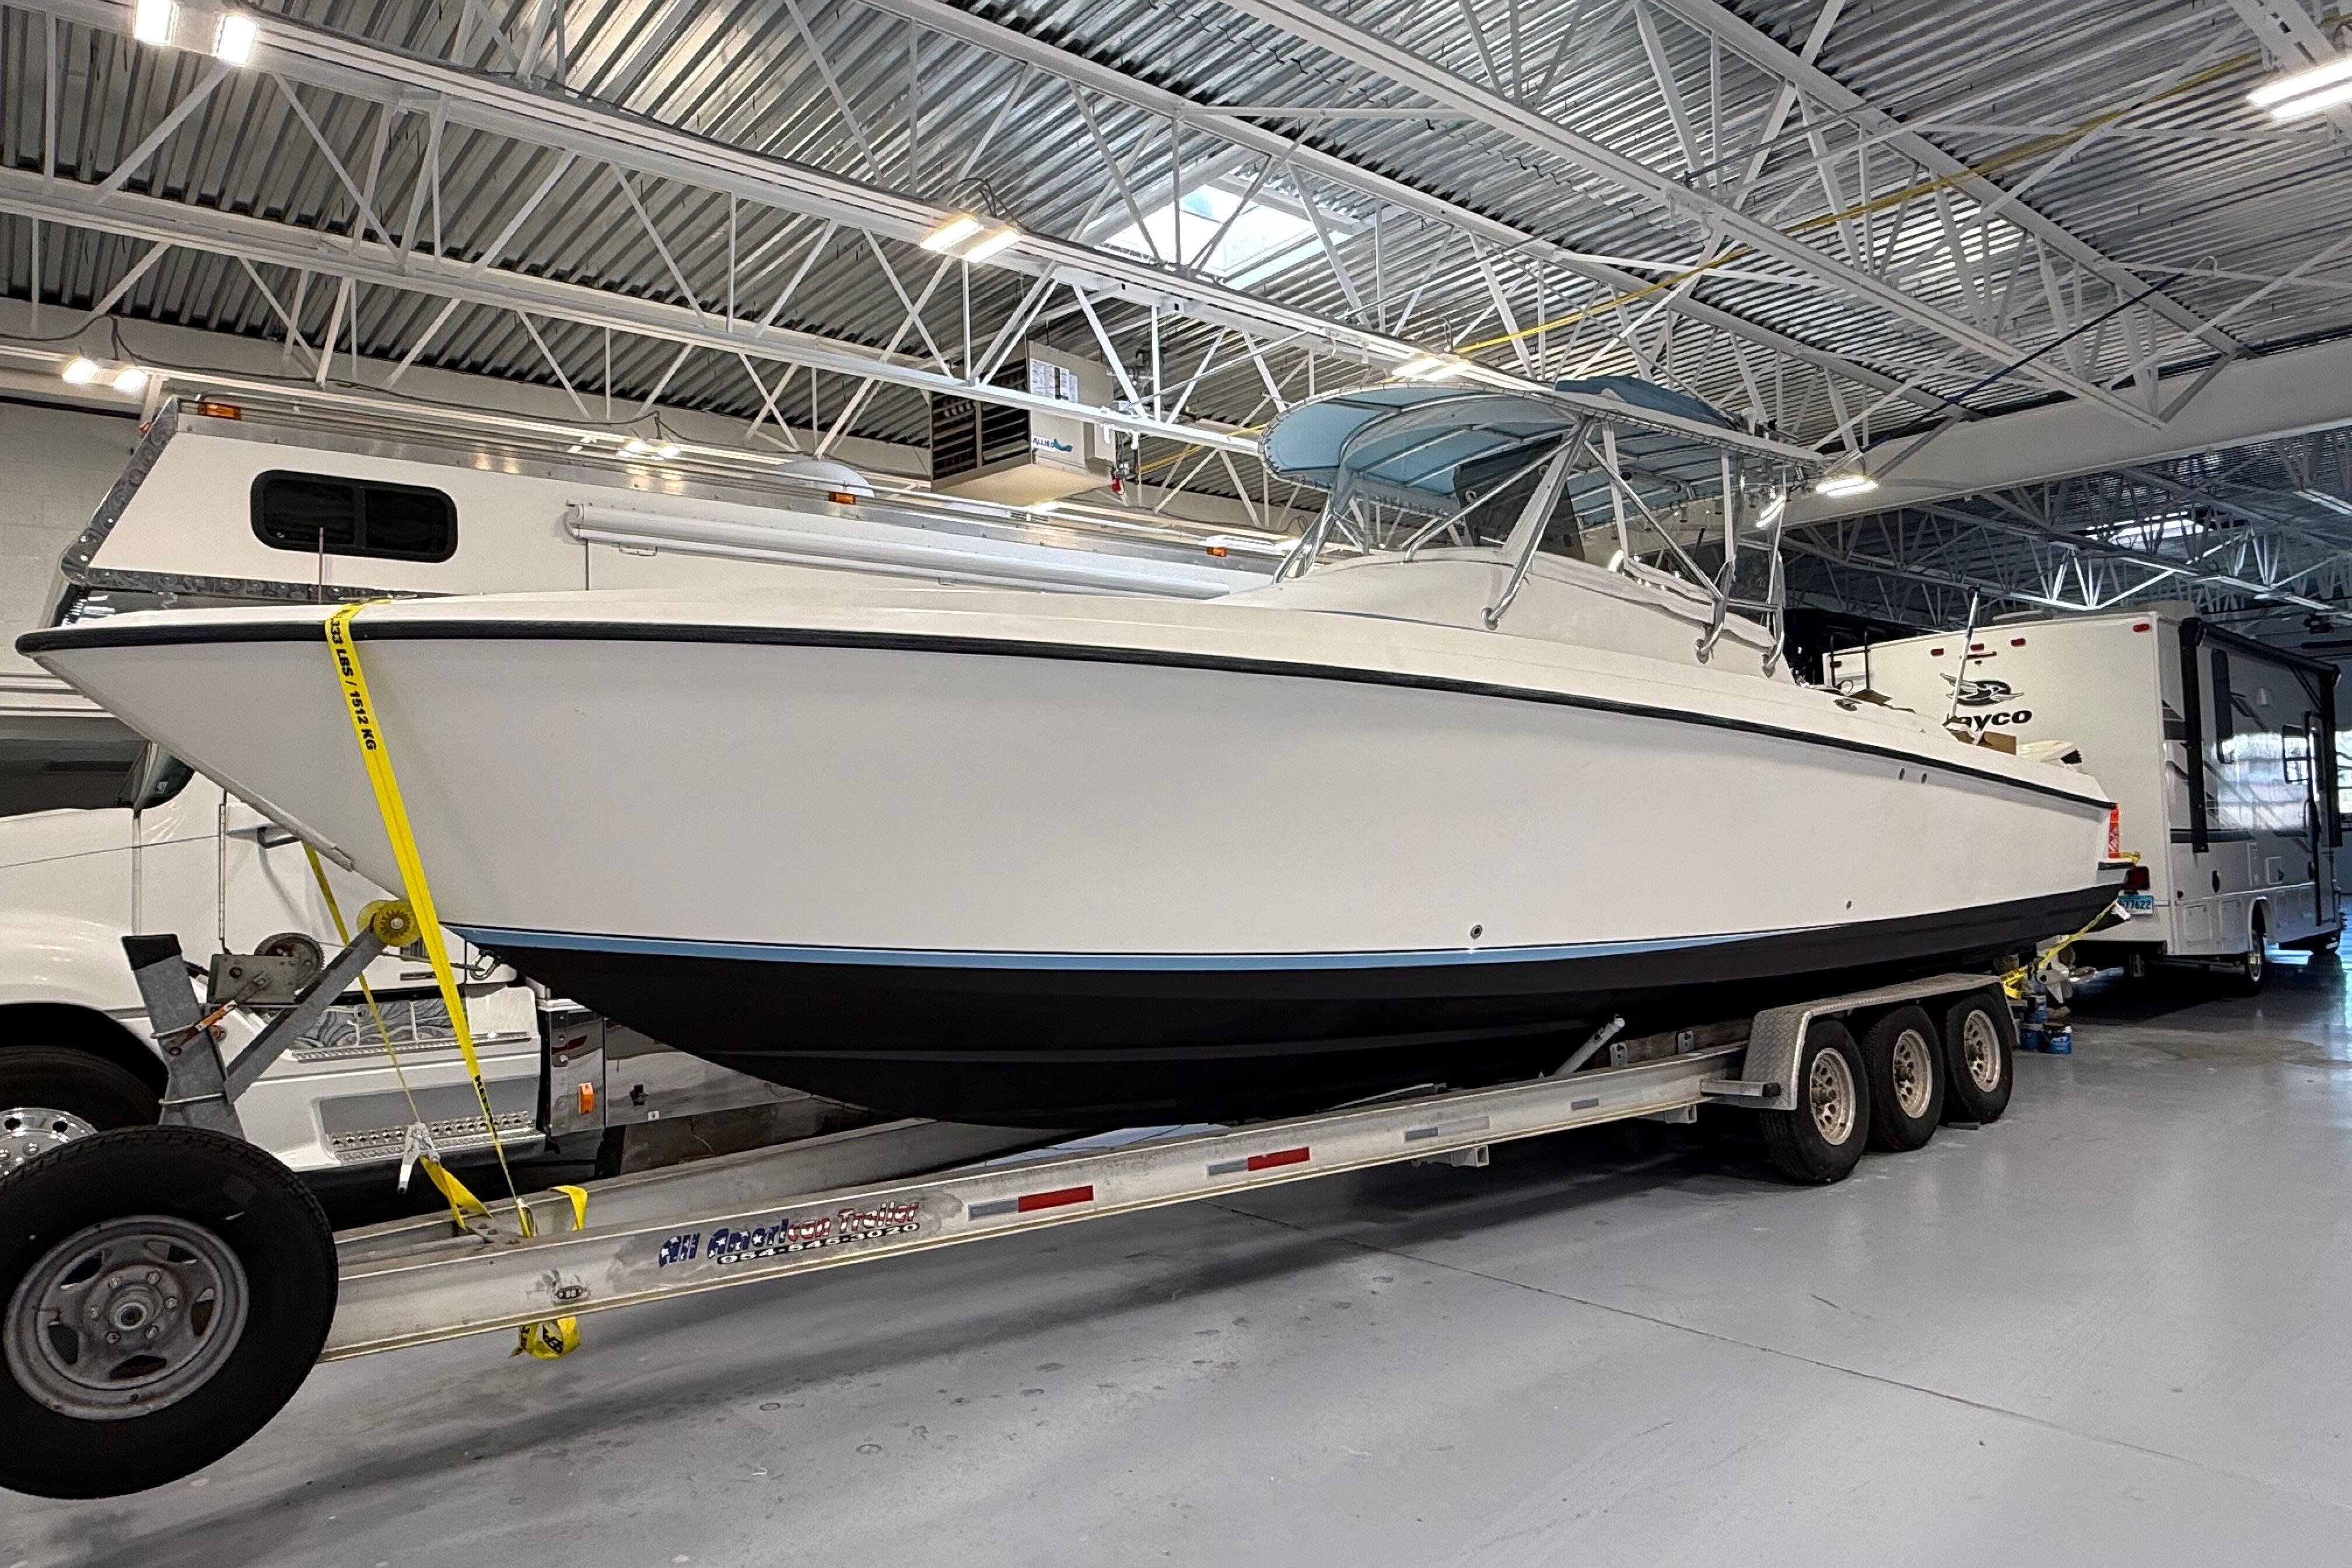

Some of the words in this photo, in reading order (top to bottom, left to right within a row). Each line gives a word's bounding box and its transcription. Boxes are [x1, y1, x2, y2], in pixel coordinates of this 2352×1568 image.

[335, 649, 354, 677] LBS
[349, 691, 369, 724] 1512
[360, 728, 377, 750] KG
[1959, 709, 2032, 732] ayco
[837, 1200, 919, 1234] Trailer
